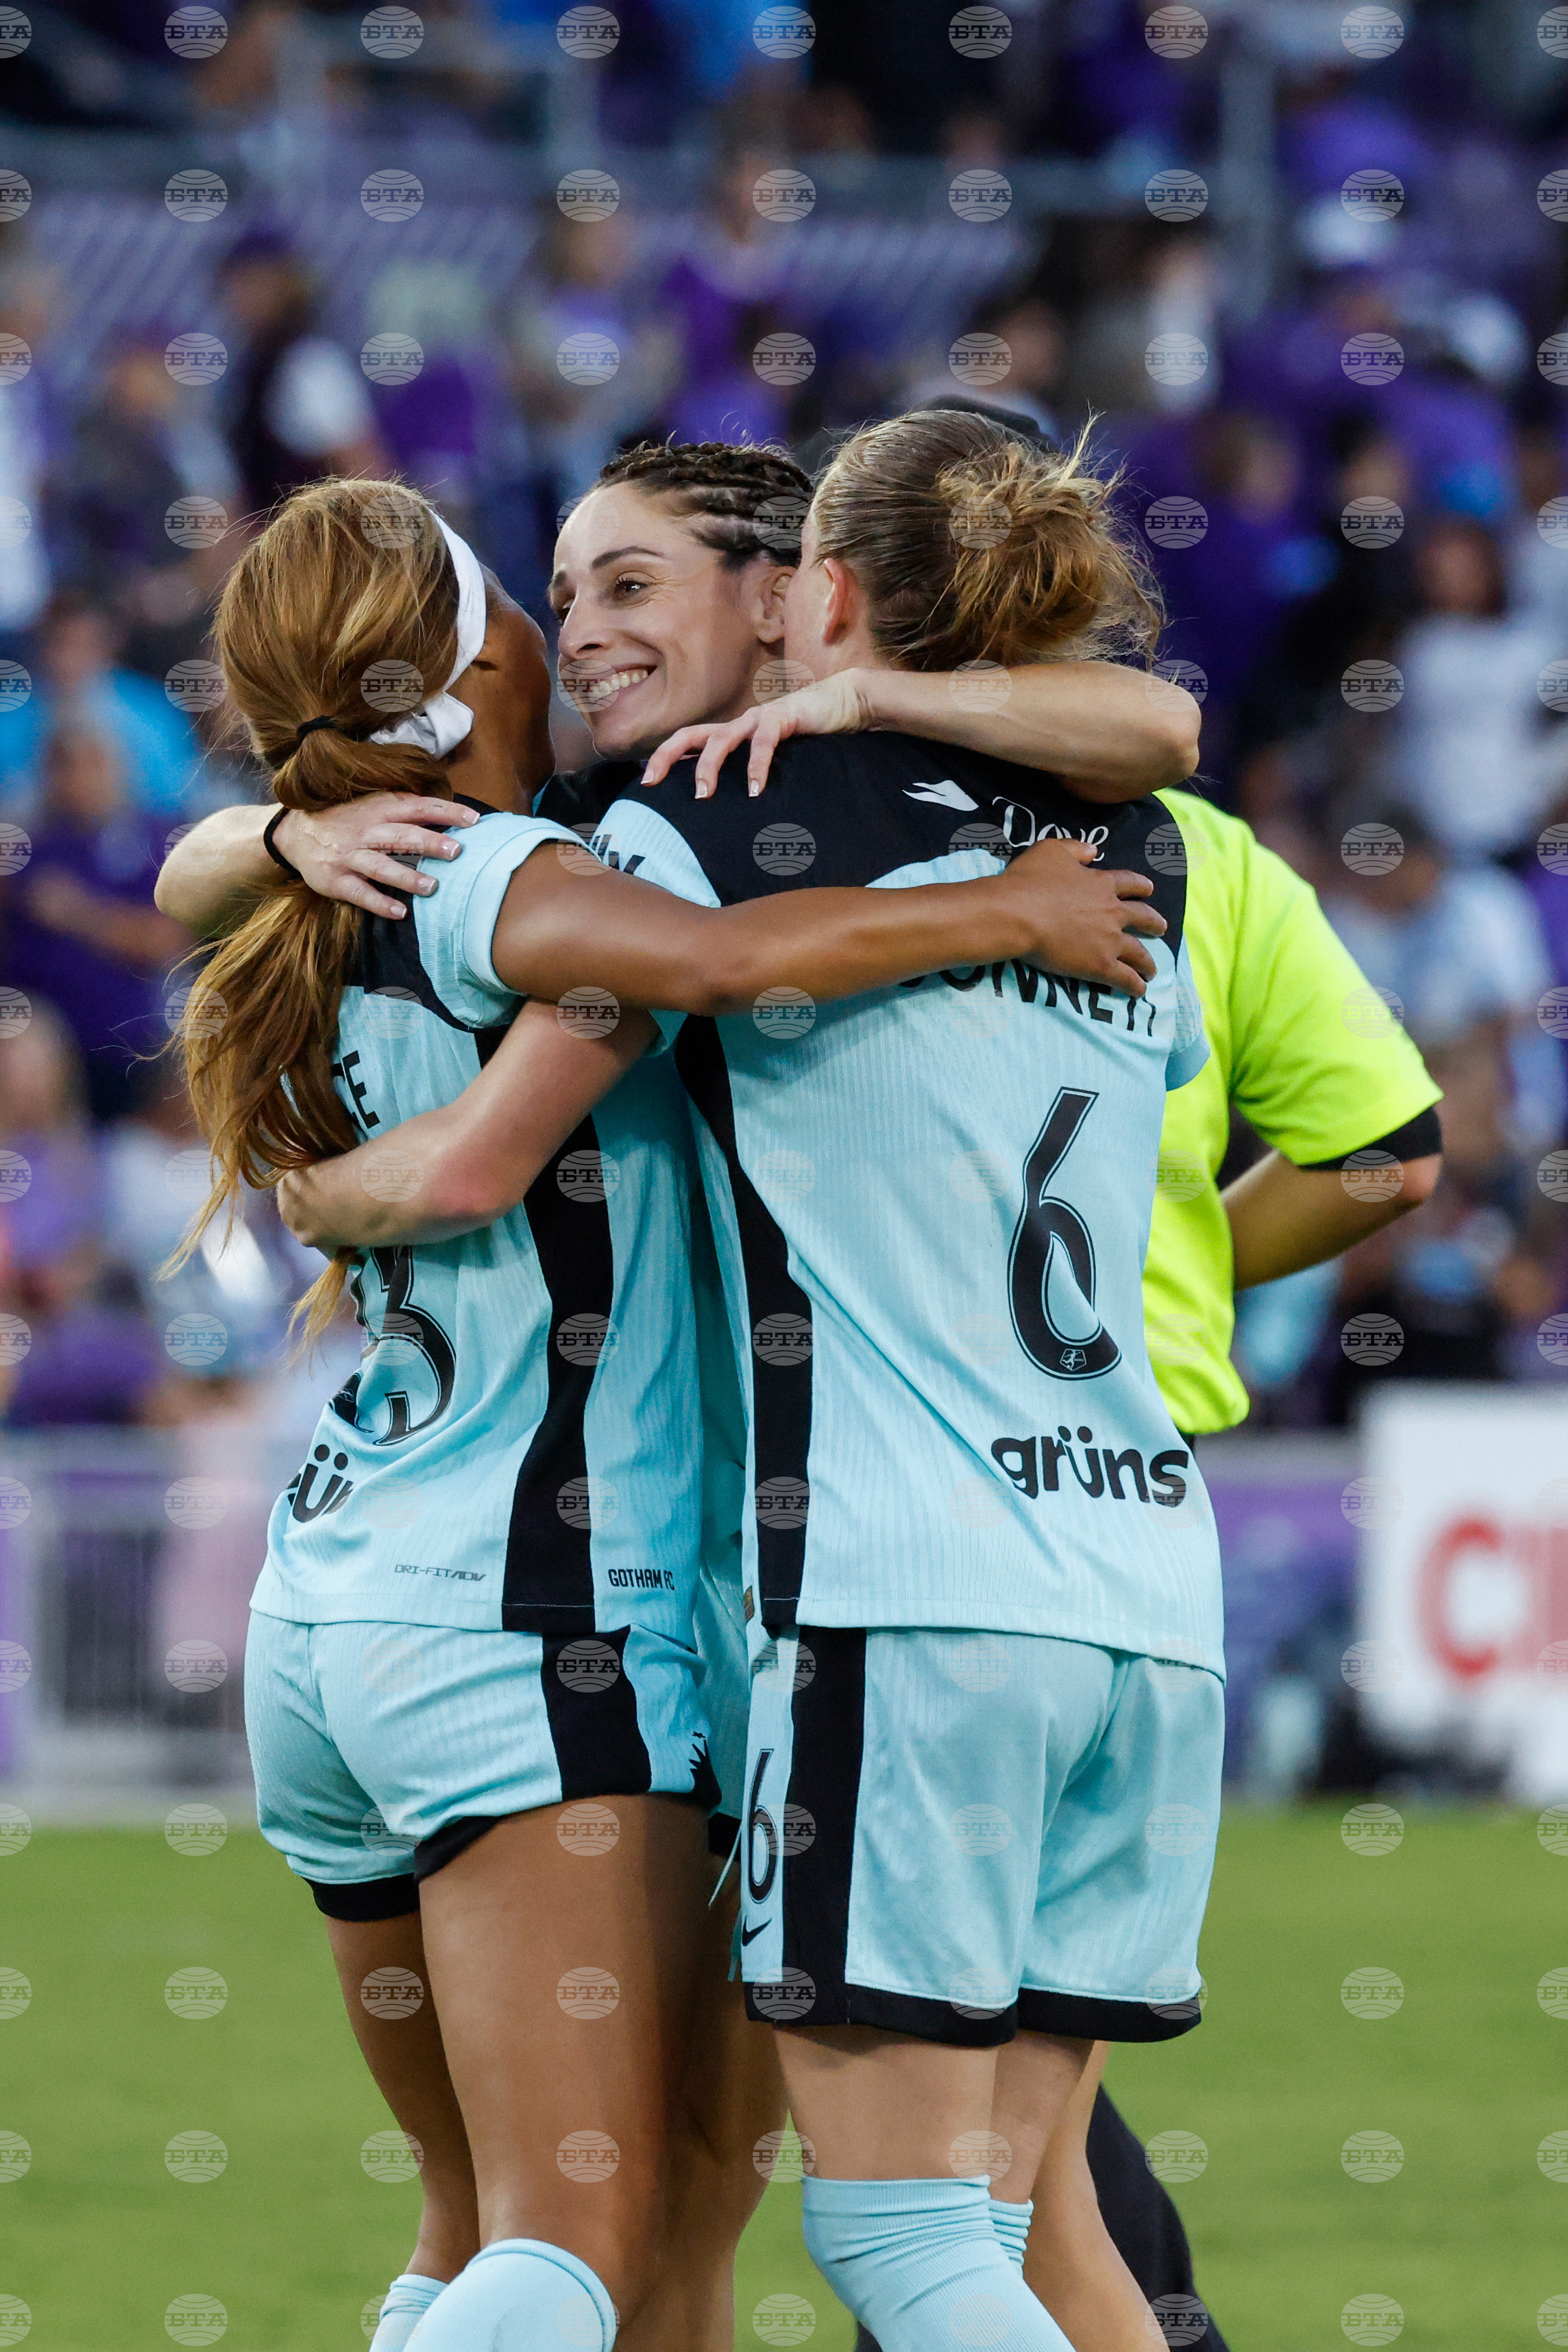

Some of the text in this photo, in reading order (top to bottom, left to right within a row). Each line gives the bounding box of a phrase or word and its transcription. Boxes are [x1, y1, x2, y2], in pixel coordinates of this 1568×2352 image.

[1008, 1087, 1121, 1381] 6
[991, 1425, 1189, 1508] grüns
[394, 1564, 453, 1577] DRI-FIT
[608, 1569, 663, 1589] GOTHAM
[747, 1748, 778, 1904] 6
